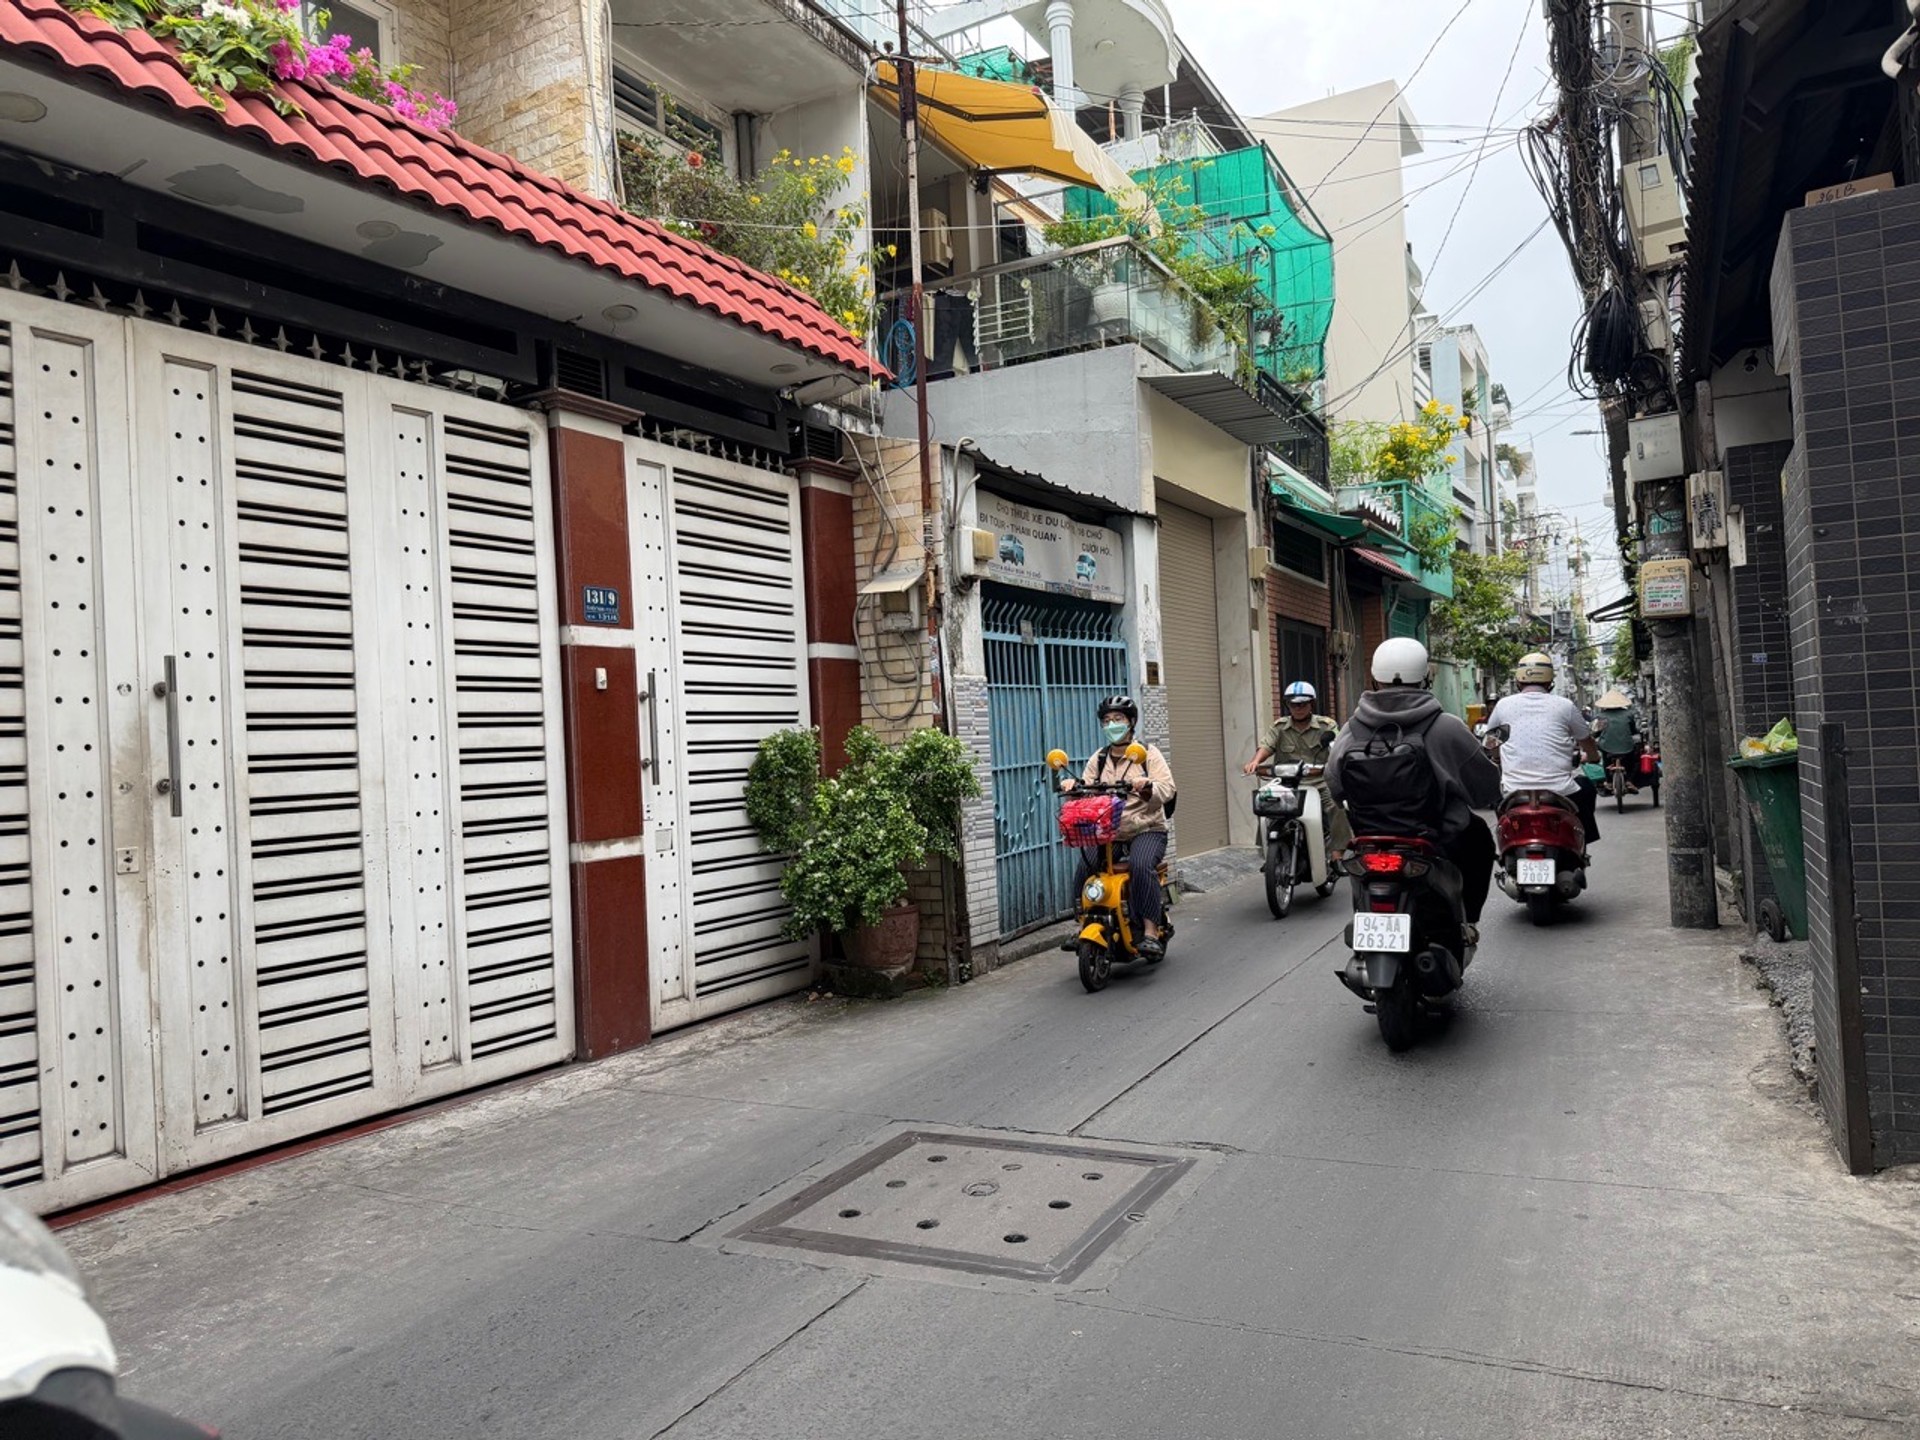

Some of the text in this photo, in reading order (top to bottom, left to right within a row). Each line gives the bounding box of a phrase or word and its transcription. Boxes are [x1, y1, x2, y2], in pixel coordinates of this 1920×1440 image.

[996, 502, 1009, 515] CHO
[1032, 514, 1043, 525] XE
[1045, 516, 1058, 527] DU
[1032, 528, 1056, 542] QUAN
[586, 589, 615, 606] 131/9
[1522, 872, 1549, 882] 7007
[1363, 916, 1401, 932] 94-AA
[1357, 933, 1406, 949] 263.21
